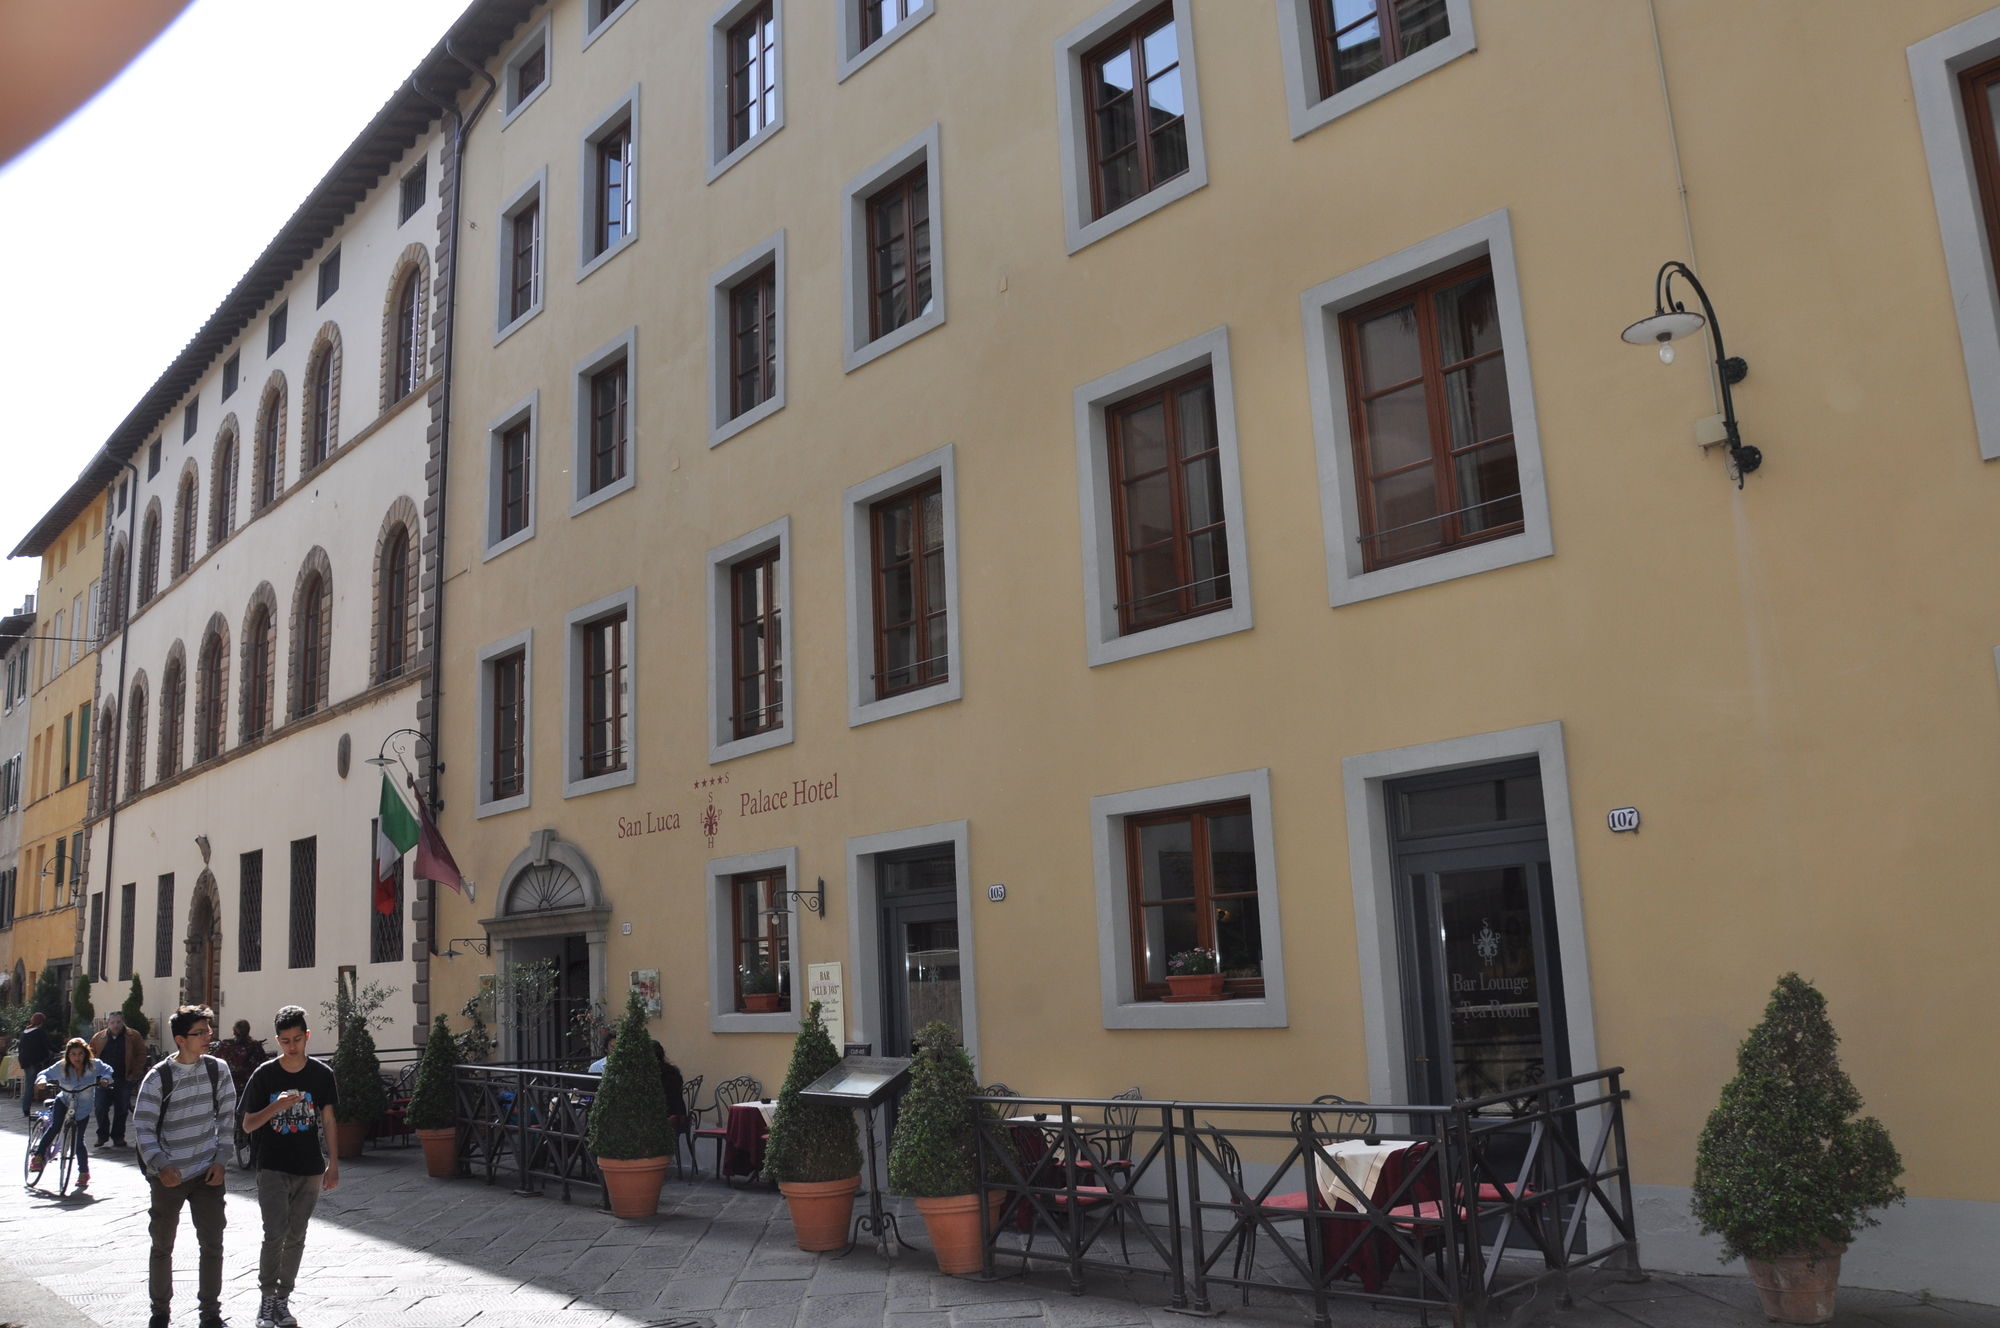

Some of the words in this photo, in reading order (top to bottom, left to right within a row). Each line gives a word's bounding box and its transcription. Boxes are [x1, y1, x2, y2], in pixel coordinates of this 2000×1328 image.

[739, 788, 788, 818] Palace
[792, 772, 839, 807] Hotel
[617, 816, 642, 839] San
[646, 811, 681, 835] Luca
[1611, 811, 1635, 828] 107
[990, 887, 1003, 898] 105
[820, 971, 830, 981] BAR
[1452, 973, 1477, 992] Bar
[1479, 971, 1529, 995] Lounge
[1460, 1000, 1487, 1019] Tea
[1488, 999, 1530, 1018] Room
